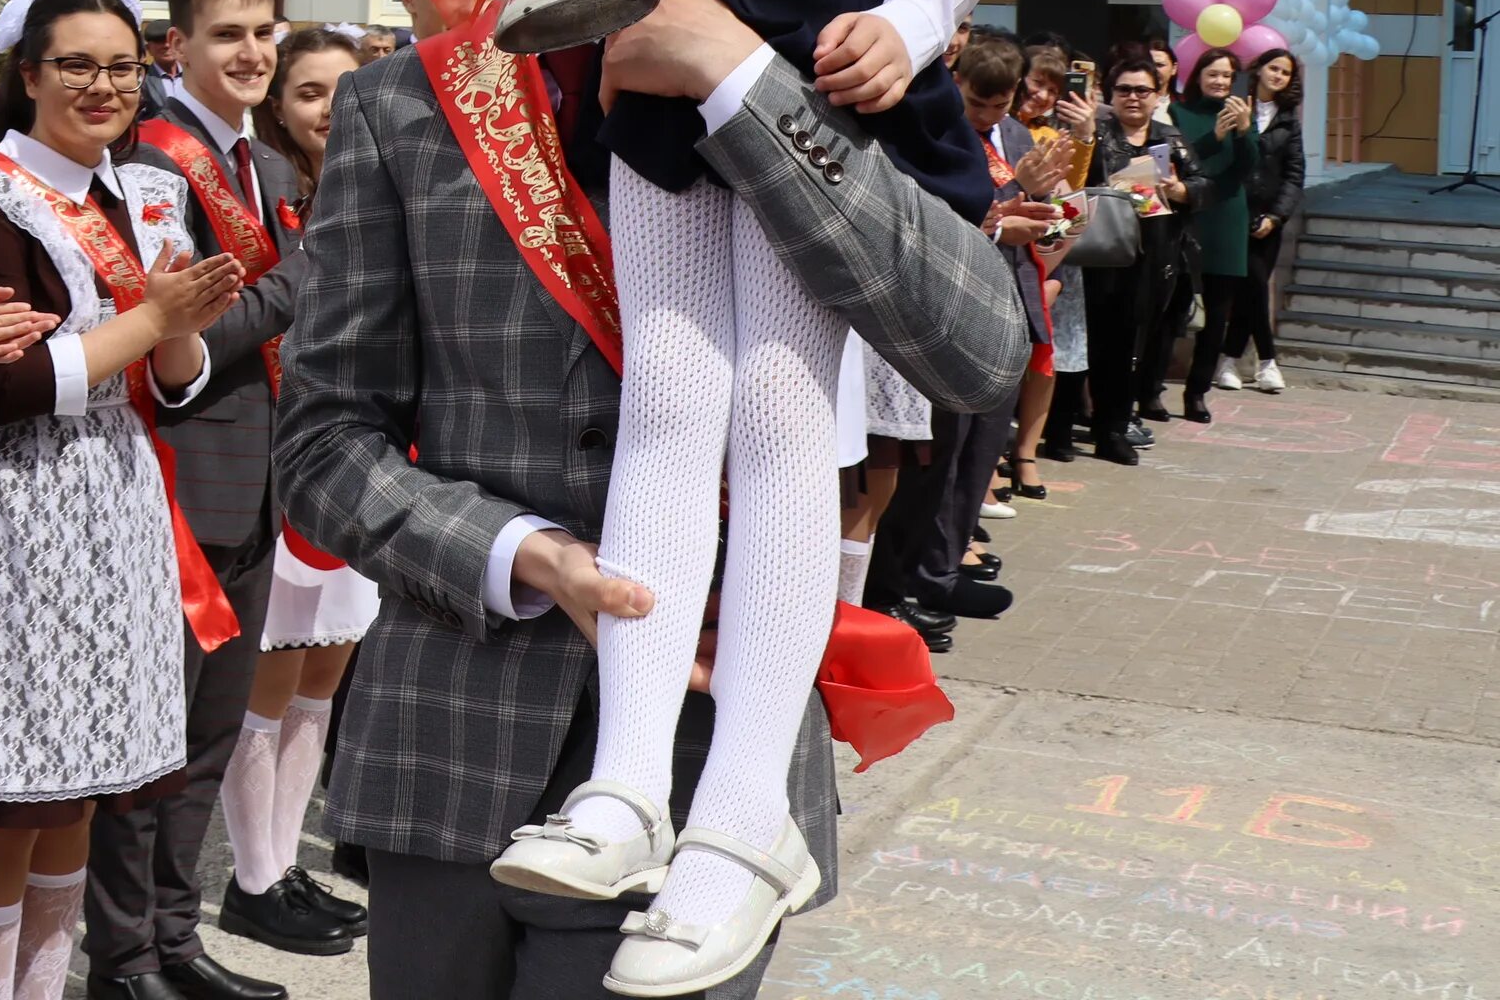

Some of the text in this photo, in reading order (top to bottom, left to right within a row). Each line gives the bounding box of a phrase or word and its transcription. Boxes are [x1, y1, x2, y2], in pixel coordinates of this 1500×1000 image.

[1066, 773, 1374, 850] 11Б
[852, 866, 1203, 955] ЕРМОЛАЕВА
[1180, 862, 1467, 937] ЕВГЕНИЙ
